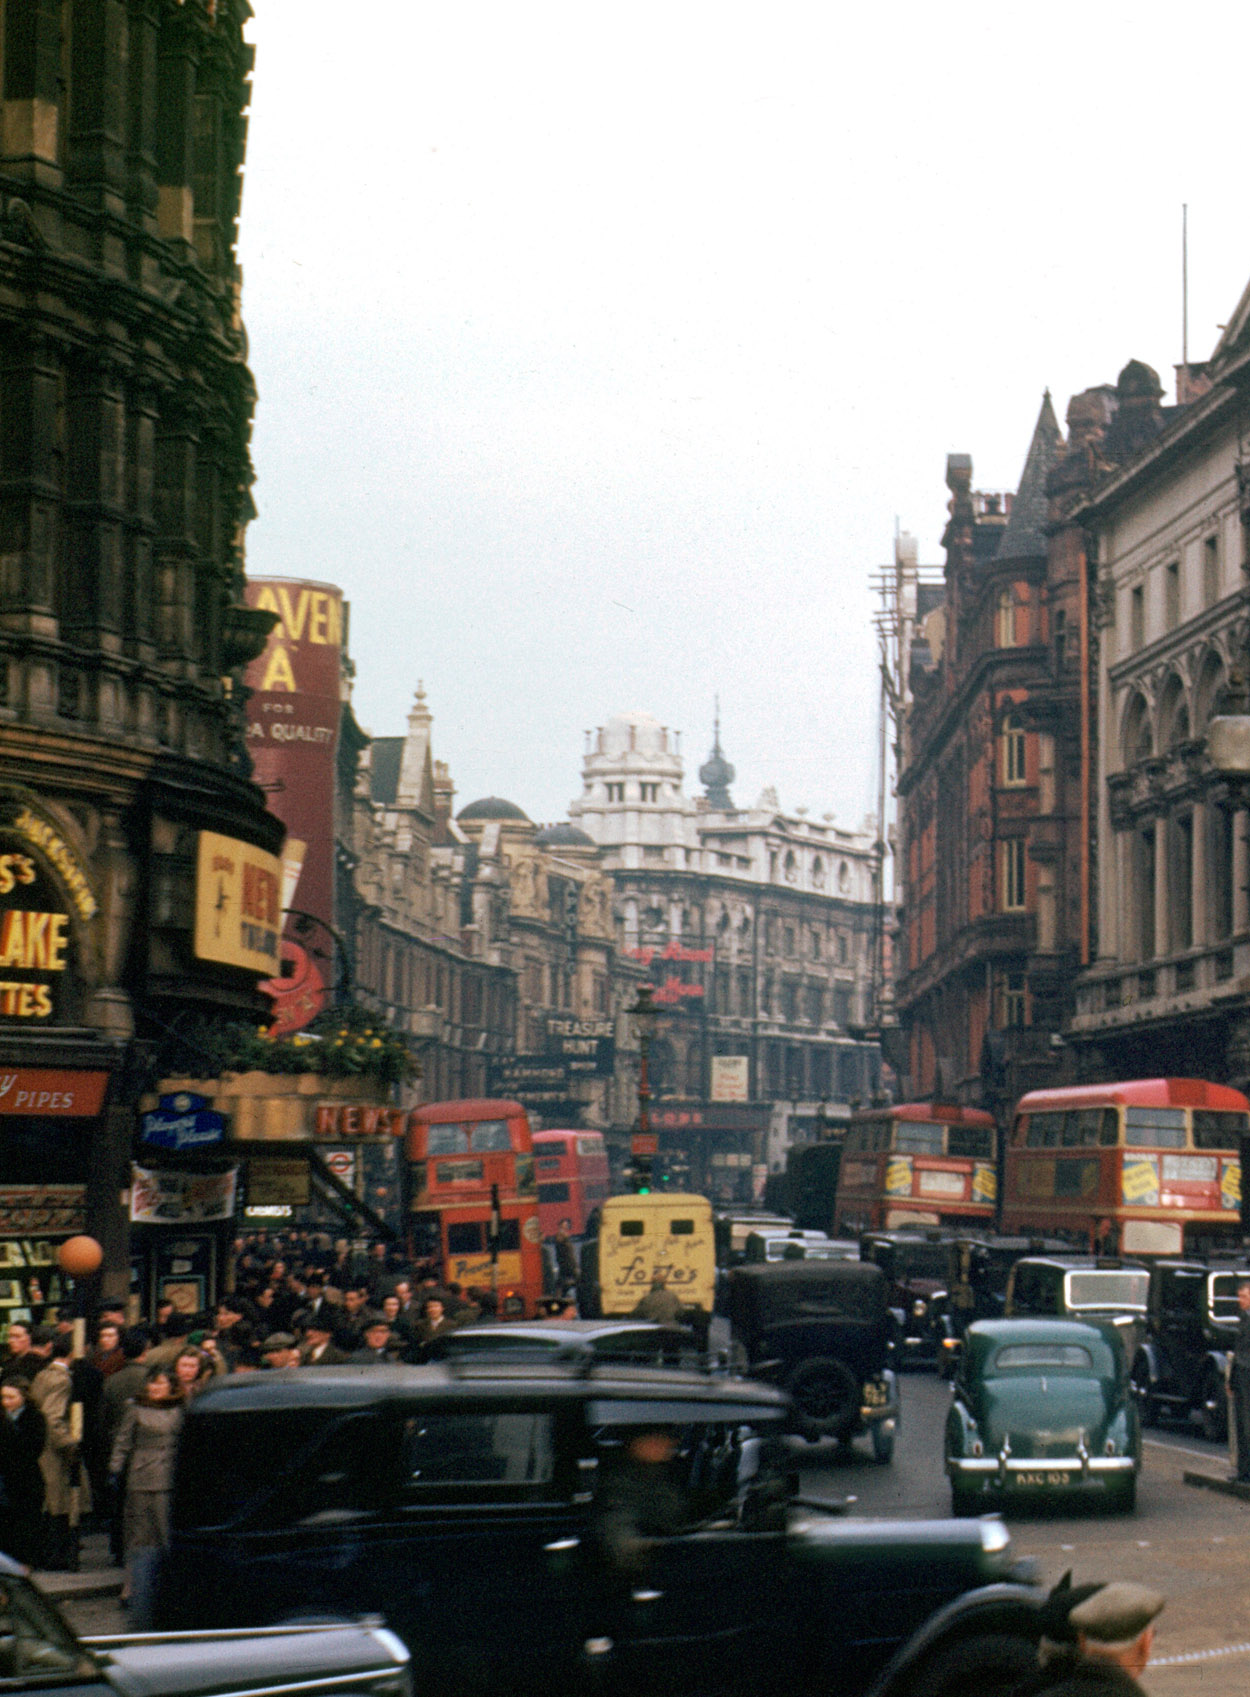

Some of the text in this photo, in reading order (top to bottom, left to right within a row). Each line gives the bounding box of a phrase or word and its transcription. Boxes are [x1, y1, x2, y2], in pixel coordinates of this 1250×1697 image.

[263, 703, 294, 714] FOR
[271, 724, 334, 743] QUALITY
[548, 1019, 614, 1037] TREASURE
[562, 1040, 598, 1054] HUNT
[14, 1090, 75, 1109] PIPES
[315, 1105, 394, 1135] NEWS
